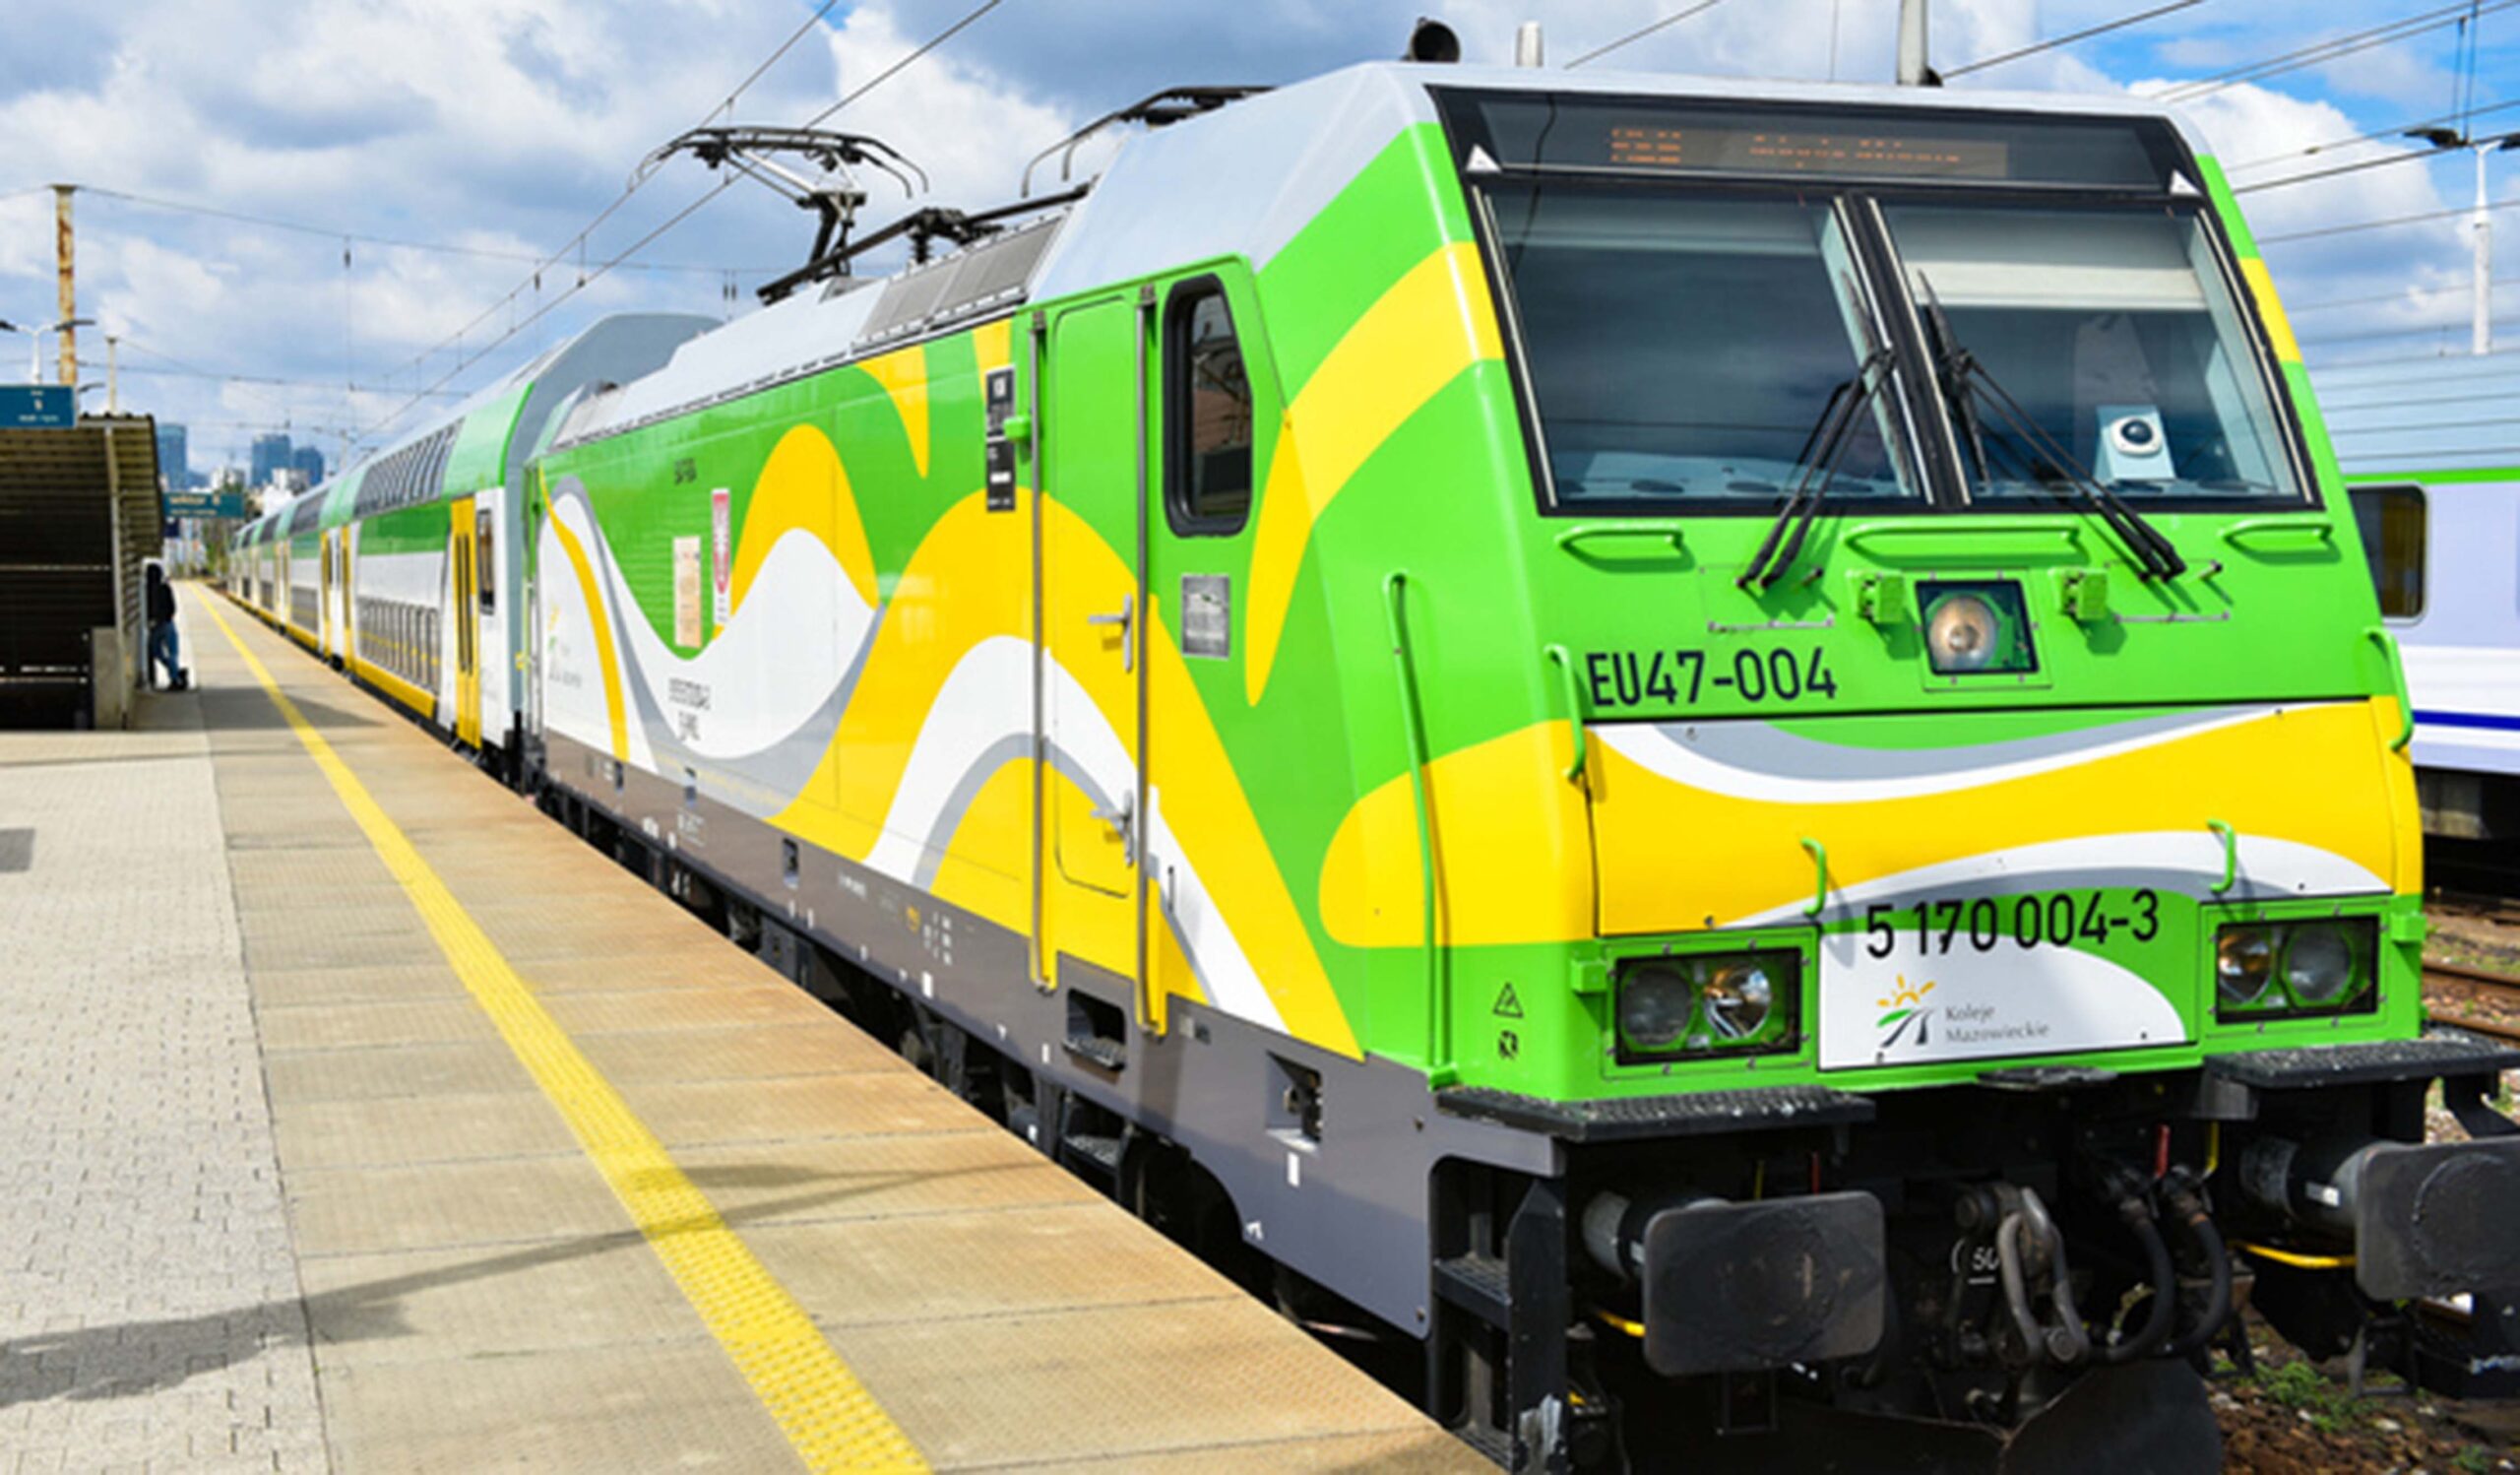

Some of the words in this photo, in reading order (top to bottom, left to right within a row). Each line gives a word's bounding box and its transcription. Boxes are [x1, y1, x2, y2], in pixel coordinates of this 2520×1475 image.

[1586, 646, 1838, 706] EU47-004
[1866, 903, 1894, 959] 5
[1913, 897, 1998, 957] 170
[2014, 888, 2160, 950] 004-3
[1946, 1002, 1996, 1023] Koleje
[1946, 1022, 2049, 1043] Mazowieckie
